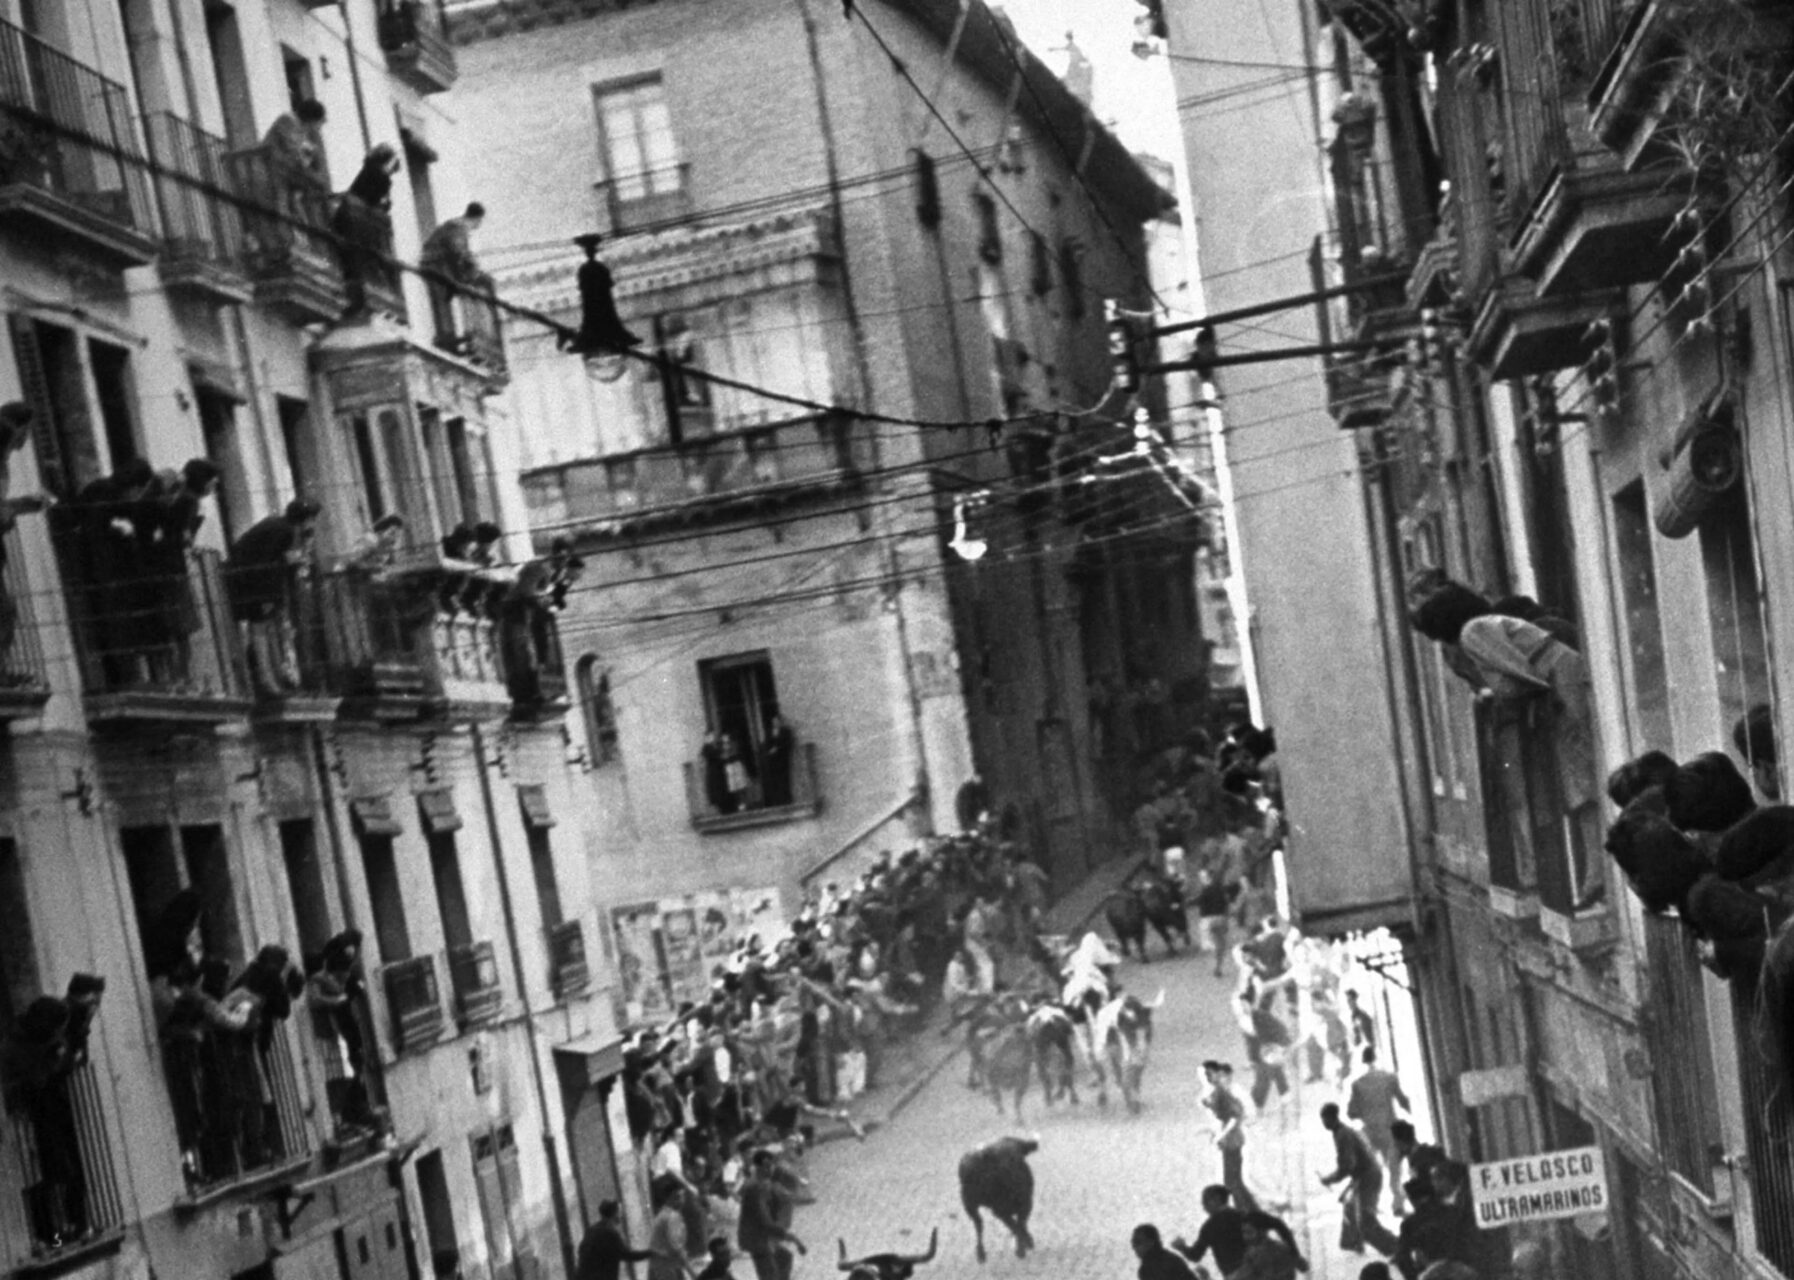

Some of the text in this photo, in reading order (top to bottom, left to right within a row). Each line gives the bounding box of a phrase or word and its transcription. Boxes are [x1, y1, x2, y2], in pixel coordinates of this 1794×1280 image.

[1480, 1153, 1593, 1190] F. VELASCO
[1480, 1184, 1603, 1222] ULTRAMARINOS
